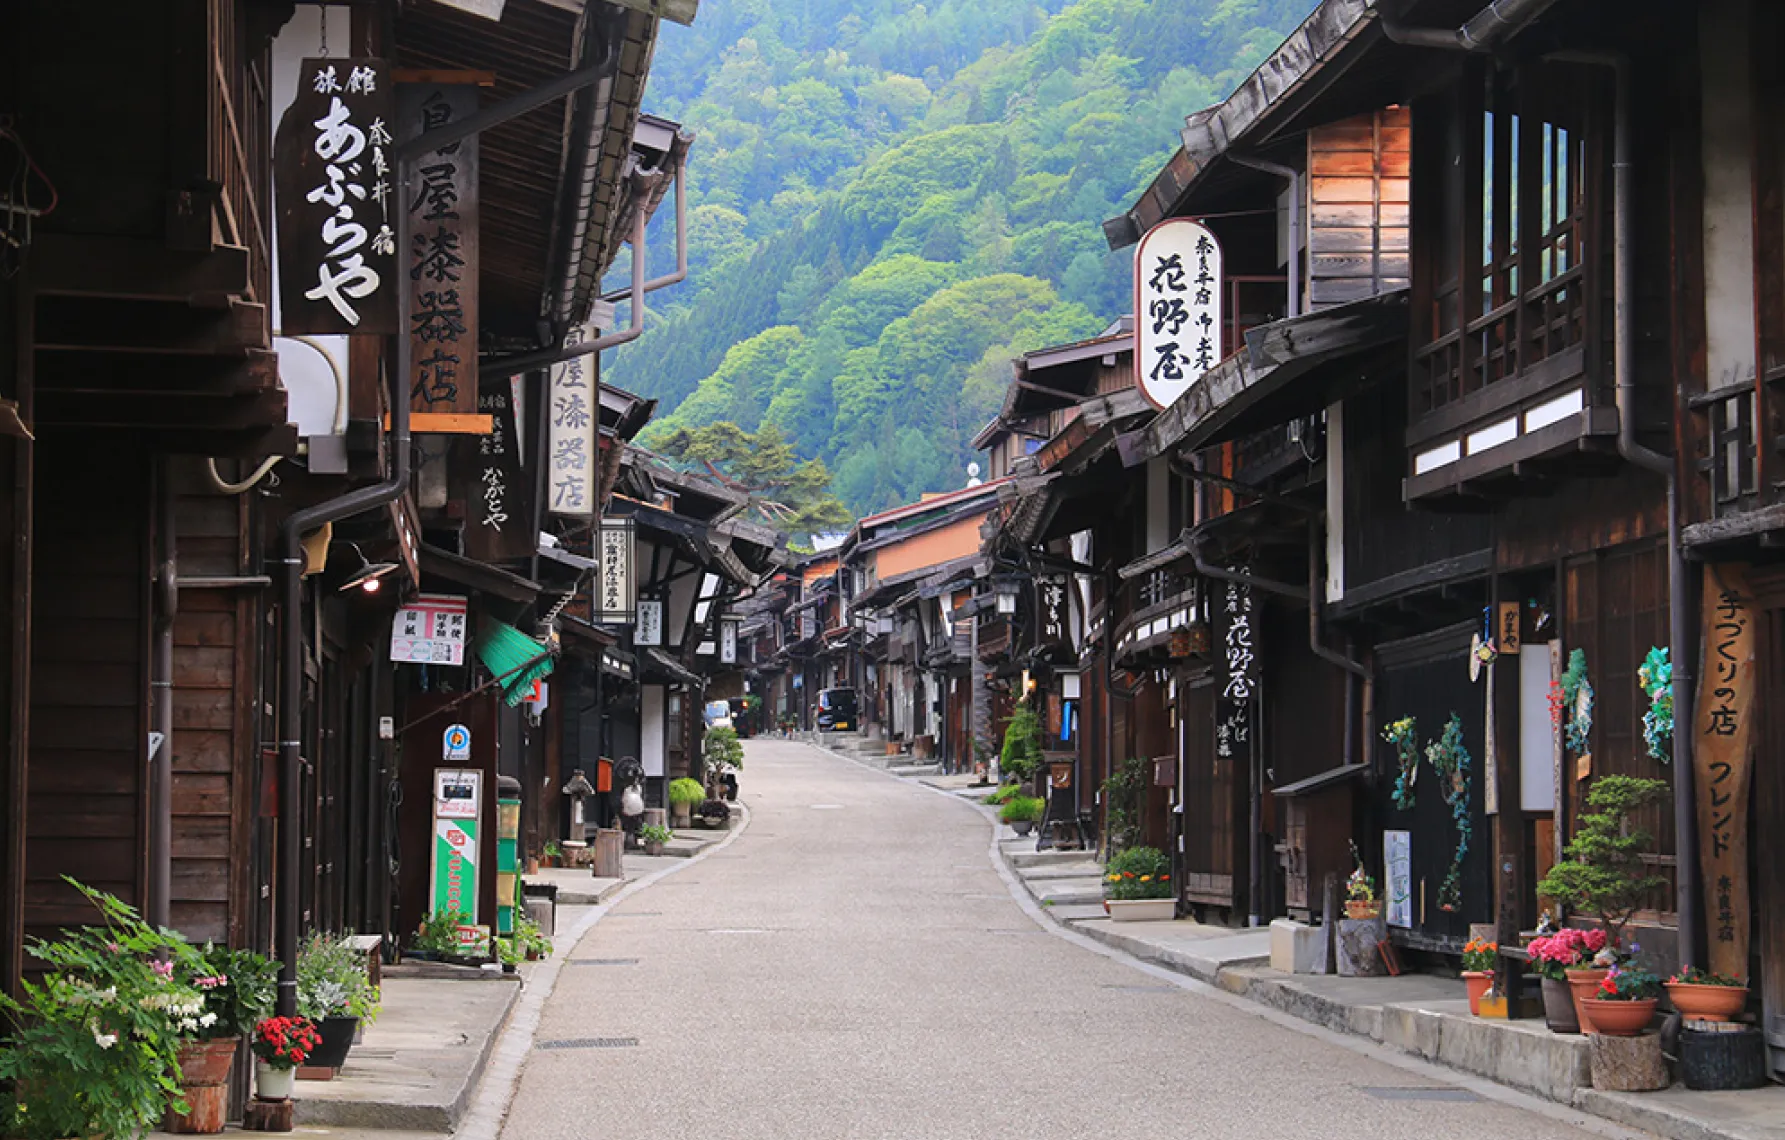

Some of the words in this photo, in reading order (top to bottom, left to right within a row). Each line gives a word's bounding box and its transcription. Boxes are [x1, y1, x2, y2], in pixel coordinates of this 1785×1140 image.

[313, 65, 377, 96] 旅館
[306, 96, 380, 326] あぶらや
[368, 116, 395, 256] 奈良井宿
[1149, 253, 1191, 382] 花野屋
[451, 615, 464, 638] 郵便
[1223, 615, 1255, 698] 花野屋
[1705, 590, 1746, 737] 手づくりの店
[1708, 762, 1734, 859] フレンド
